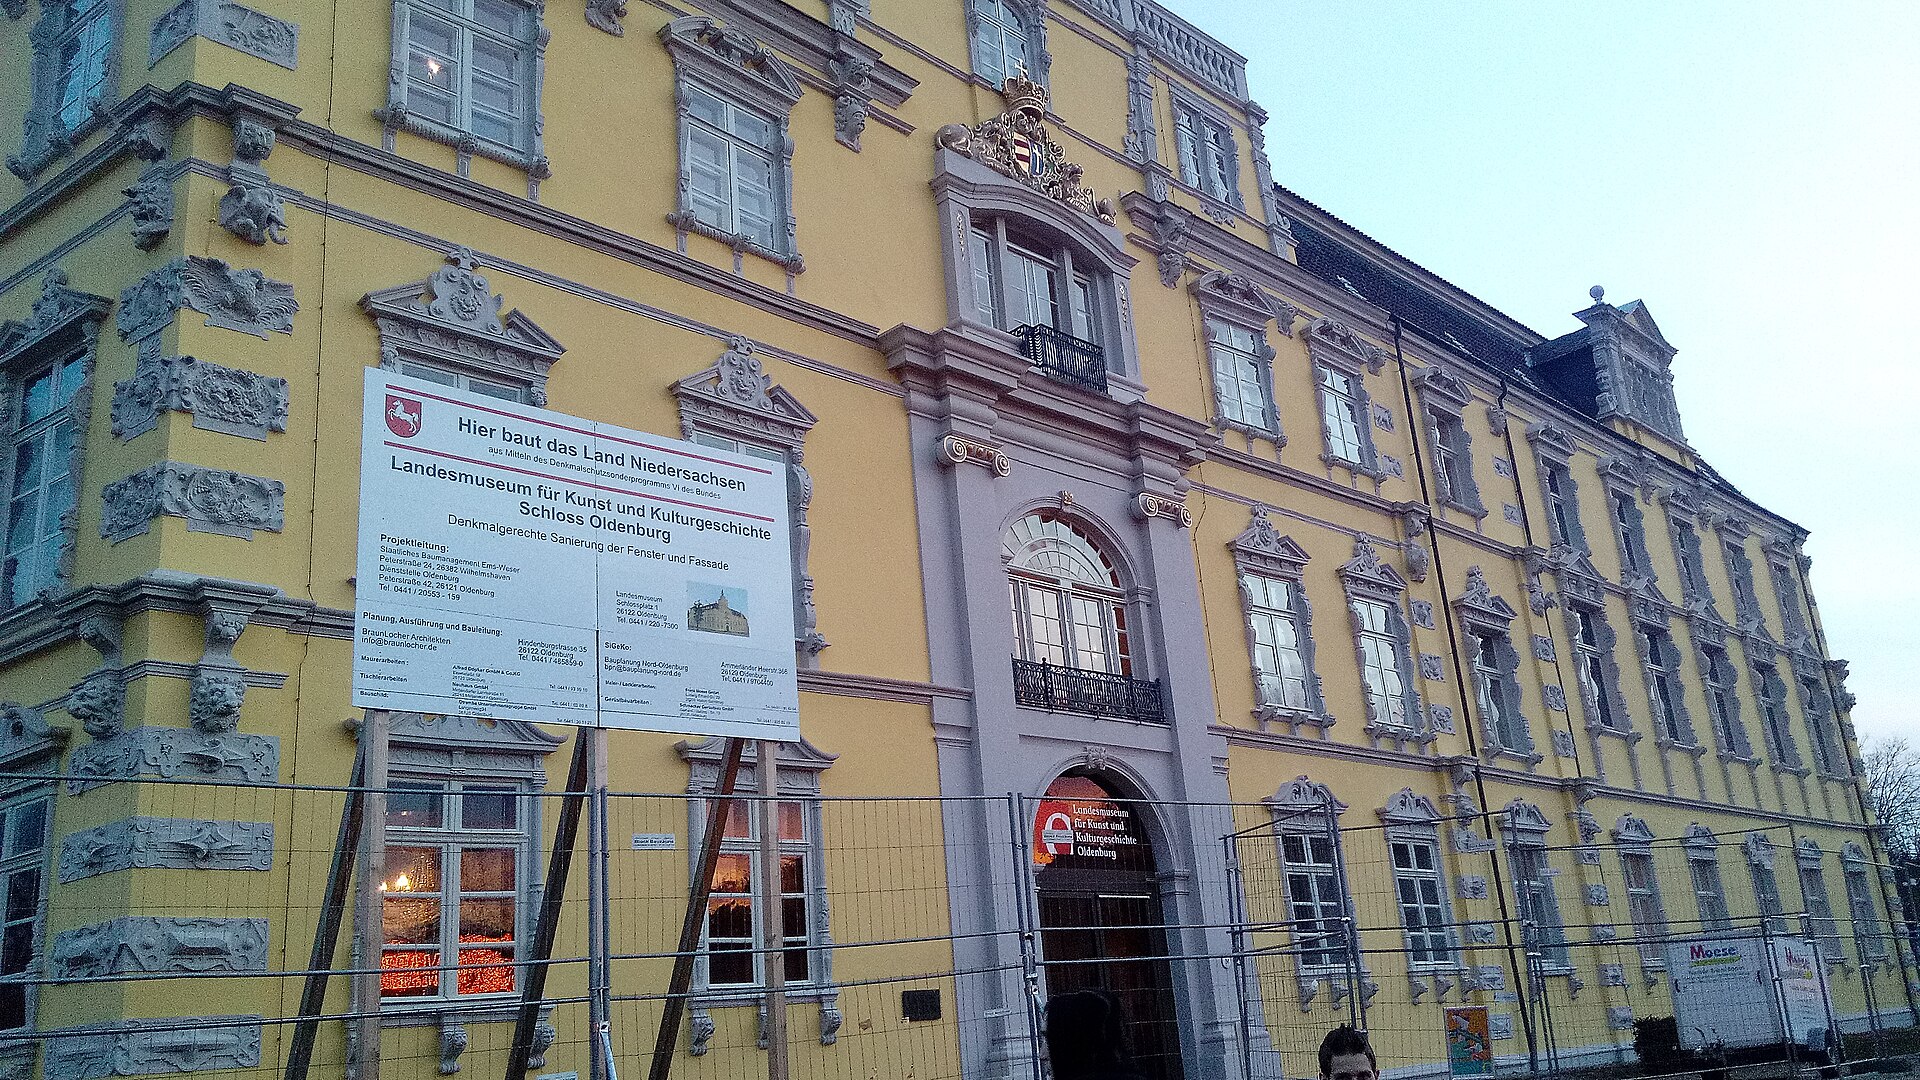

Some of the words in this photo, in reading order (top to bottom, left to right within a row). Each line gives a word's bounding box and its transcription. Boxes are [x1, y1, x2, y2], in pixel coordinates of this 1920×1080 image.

[458, 417, 496, 439] Hier
[502, 427, 542, 449] baut
[546, 438, 578, 457] das
[583, 445, 624, 467] Land
[631, 455, 746, 492] Niedersachsen
[488, 446, 503, 456] aus
[505, 448, 531, 462] Mitteln
[534, 454, 548, 465] des
[550, 458, 671, 490] Denkmalschutzsonderprogramms
[672, 483, 680, 491] VI
[682, 484, 694, 494] des
[695, 487, 722, 500] Bundes
[392, 456, 532, 496] Landesmuseum
[536, 484, 560, 502] für
[565, 490, 612, 512] Kunst
[616, 502, 646, 518] und
[650, 506, 772, 540] Kulturgeschichte
[519, 501, 584, 526] Schloss
[590, 515, 671, 544] Oldenburg
[380, 534, 450, 553] Projektleitung:
[448, 514, 547, 542] Denkmalgerechte
[550, 531, 604, 553] Sanierung
[607, 543, 624, 554] der
[627, 546, 665, 560] Fenster
[668, 553, 686, 564] und
[688, 556, 729, 571] Fassade
[380, 546, 420, 558] Staatliches
[421, 552, 480, 568] Baumanagement
[481, 562, 520, 574] Ems-Weser
[380, 555, 422, 568] Peterstraße
[423, 562, 435, 571] 24,
[436, 564, 459, 574] 26382
[460, 567, 511, 580] Wilhelmshaven
[380, 564, 421, 577] Dienststelle
[422, 571, 460, 583] Oldenburg
[379, 574, 421, 586] Peterstraße
[436, 584, 457, 592] 26121
[460, 586, 495, 598] Oldenburg
[379, 584, 392, 592] Tel.
[394, 586, 412, 594] 0441
[418, 588, 440, 598] 20553
[616, 590, 663, 603] Landesmuseum
[616, 599, 654, 611] Schlossplatz
[616, 616, 628, 624] Tel.
[628, 617, 644, 626] 0441
[636, 610, 668, 622] Oldenburg
[362, 612, 398, 625] Planung,
[399, 616, 444, 630] Ausführung
[446, 622, 460, 631] und
[462, 624, 504, 638] Bauleitung:
[362, 628, 410, 640] BraunLocher
[410, 633, 451, 645] Architekten
[362, 636, 438, 652] info@braunlocher.de
[518, 638, 578, 652] Hindenburgstrasse
[604, 642, 632, 651] SiGeKo:
[360, 654, 406, 666] Maurerarbeiten
[518, 646, 539, 655] 26122
[540, 649, 574, 660] Oldenburg
[531, 655, 548, 663] 0441
[604, 656, 641, 668] Bauplanung
[642, 660, 689, 672] Nord-Oldenburg
[360, 672, 408, 683] Tischlerarbeiten
[738, 670, 768, 680] Oldenburg
[1073, 804, 1130, 818] Landesmuseum
[1074, 818, 1086, 828] für
[1087, 819, 1109, 830] Kunst
[1110, 821, 1125, 831] und
[1076, 832, 1138, 847] Kulturgeschichte
[1078, 846, 1117, 860] Oldenburg
[1690, 944, 1738, 961] Moese
